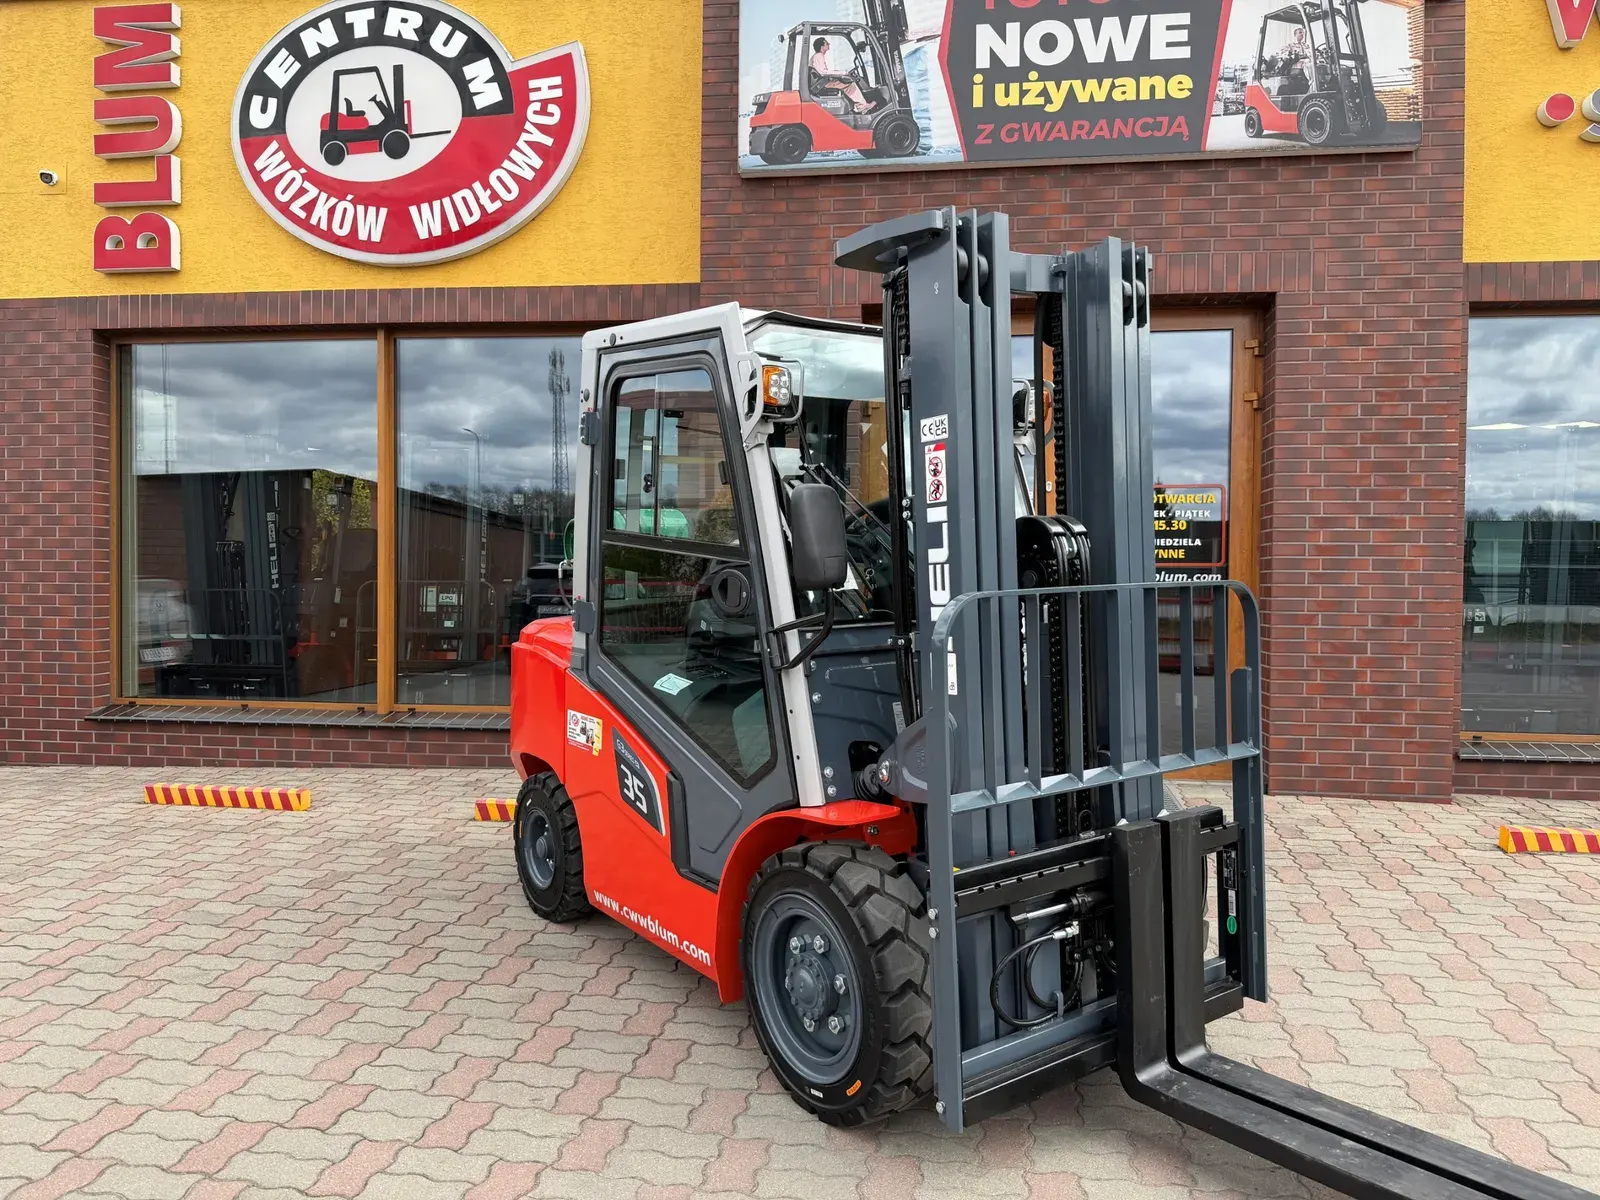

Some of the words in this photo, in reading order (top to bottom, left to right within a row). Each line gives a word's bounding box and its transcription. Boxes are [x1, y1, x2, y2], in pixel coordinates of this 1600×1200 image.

[974, 12, 1192, 69] NOWE
[249, 6, 503, 130] CENTRUM
[972, 73, 984, 108] i
[994, 70, 1193, 113] używane
[93, 3, 180, 273] BLUM
[974, 124, 995, 145] Z
[1000, 115, 1190, 143] GWARANCJĄ
[253, 139, 389, 243] WÓZKÓW
[408, 75, 564, 240] WIDŁOWYCH
[1153, 493, 1216, 504] TWARCIA
[1175, 510, 1211, 519] PIĄTEK
[269, 542, 279, 589] HELI
[1155, 571, 1221, 581] lum.com
[620, 764, 648, 814] 35
[593, 889, 711, 966] www.cwwblum.com
